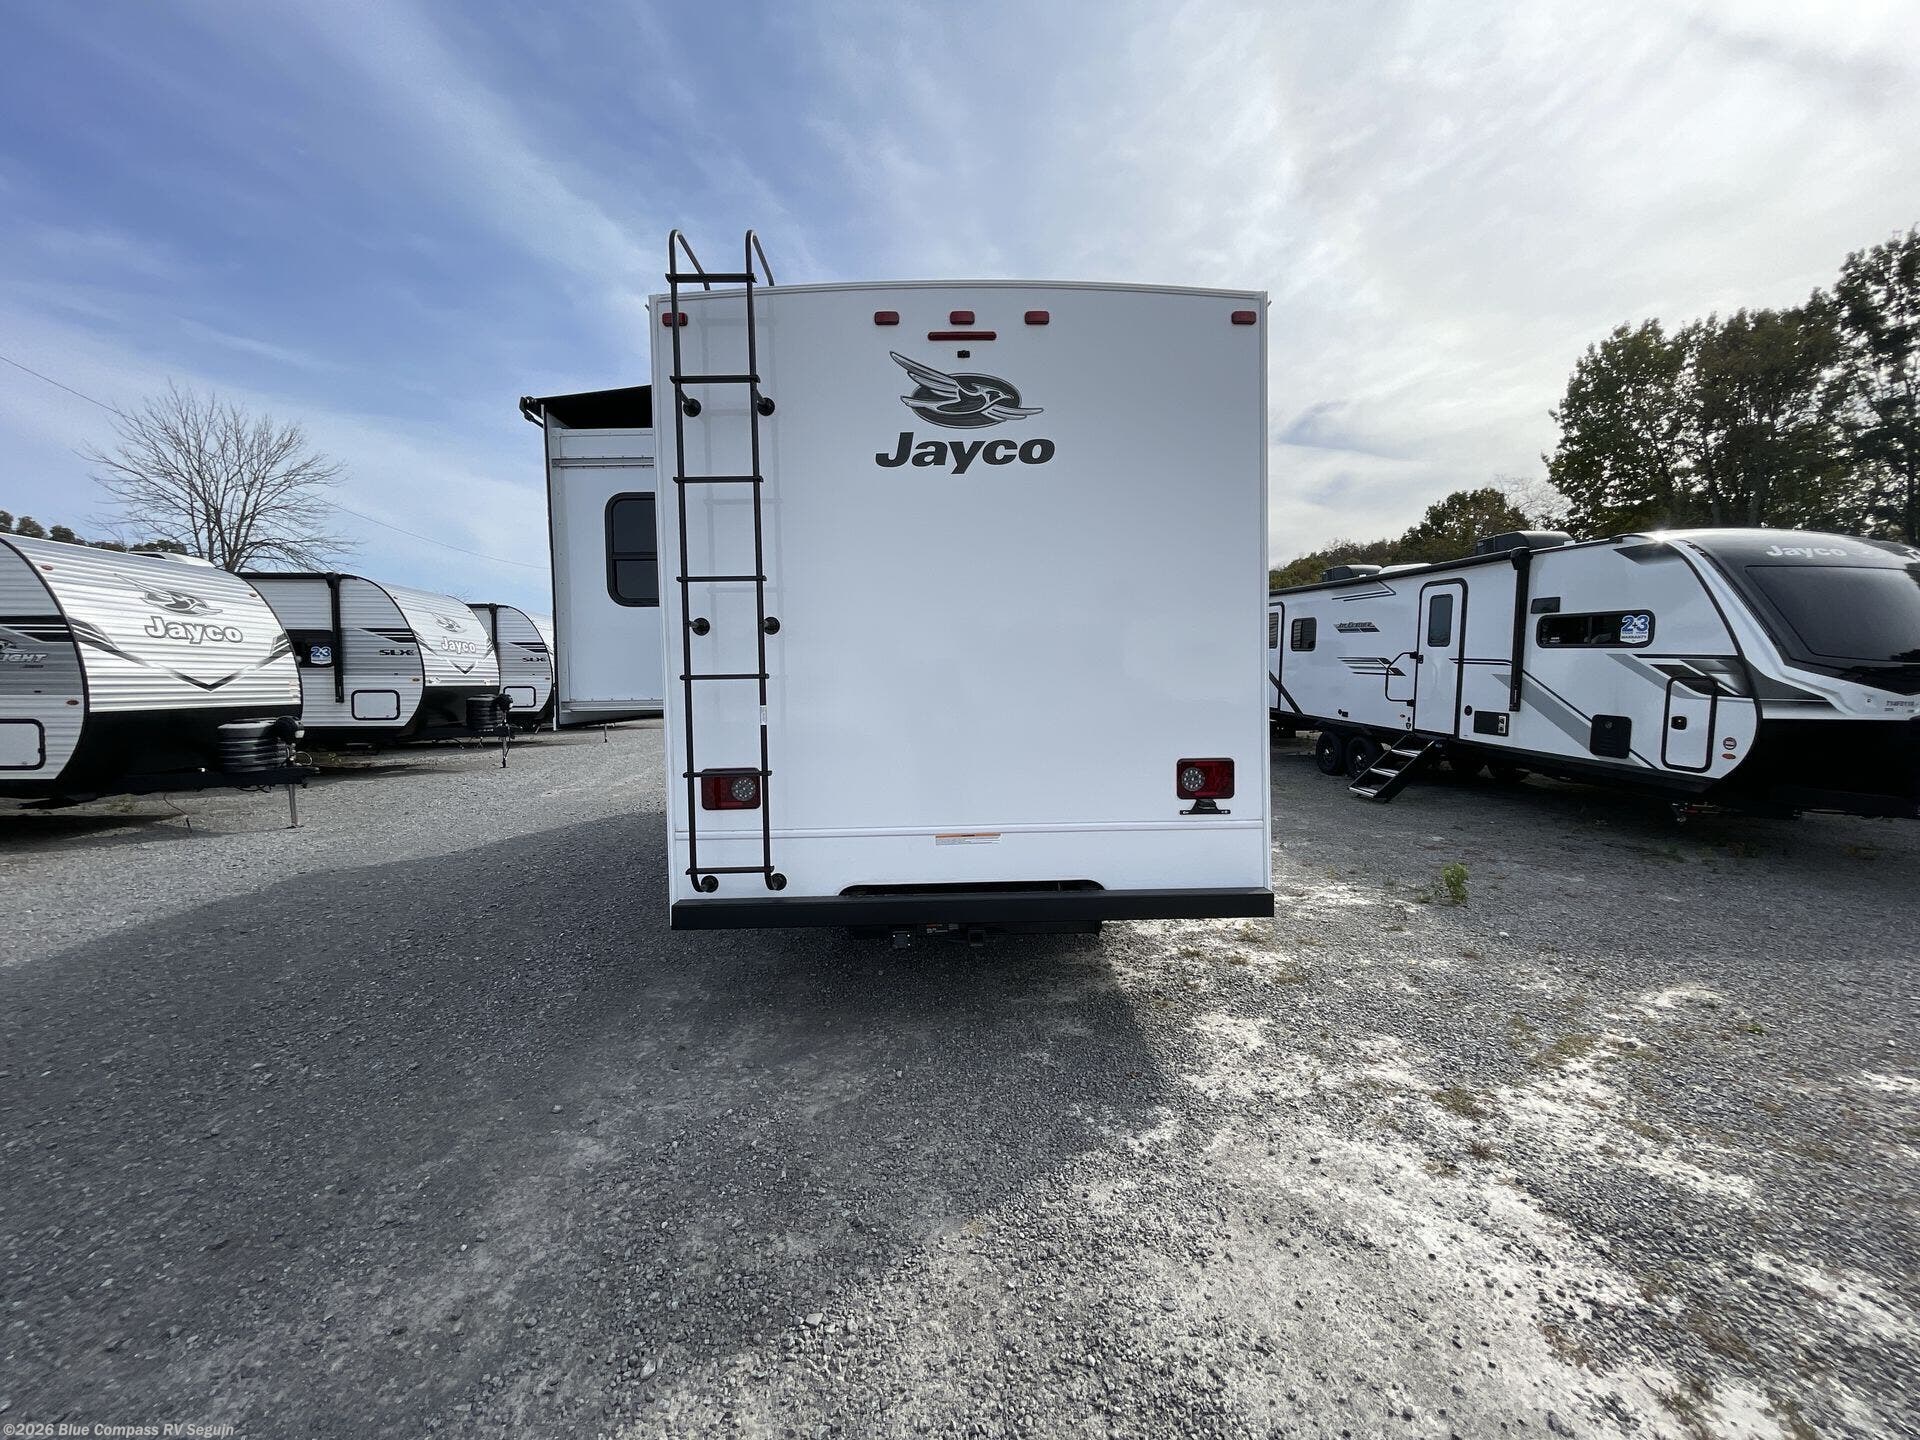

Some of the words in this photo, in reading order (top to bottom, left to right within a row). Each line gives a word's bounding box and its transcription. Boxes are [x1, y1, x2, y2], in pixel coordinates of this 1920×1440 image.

[875, 432, 1056, 475] Jayco
[1766, 545, 1848, 558] Jayco
[144, 616, 244, 645] Jayco
[441, 636, 477, 655] Jayco
[0, 653, 48, 662] IGHT
